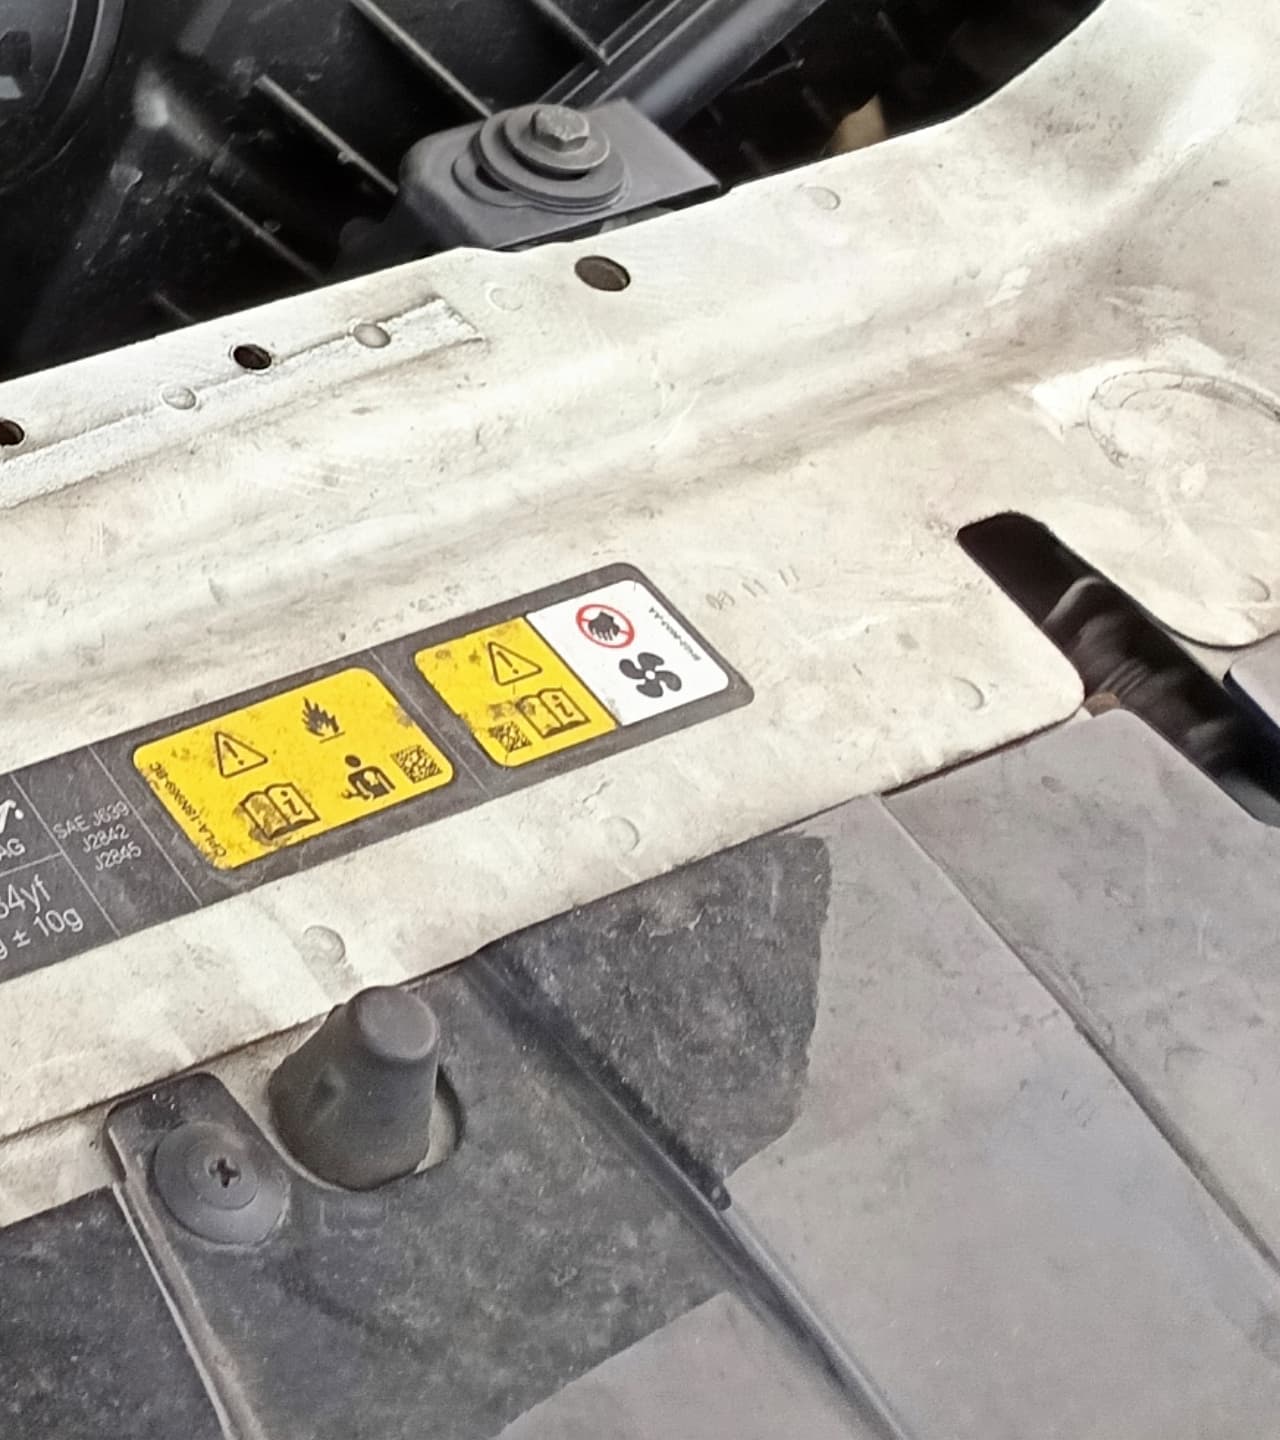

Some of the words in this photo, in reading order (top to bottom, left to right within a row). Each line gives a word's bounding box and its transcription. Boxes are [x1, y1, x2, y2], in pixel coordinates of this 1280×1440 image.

[52, 815, 90, 840] SAE
[81, 824, 130, 853] J2842
[33, 908, 84, 937] 10g
